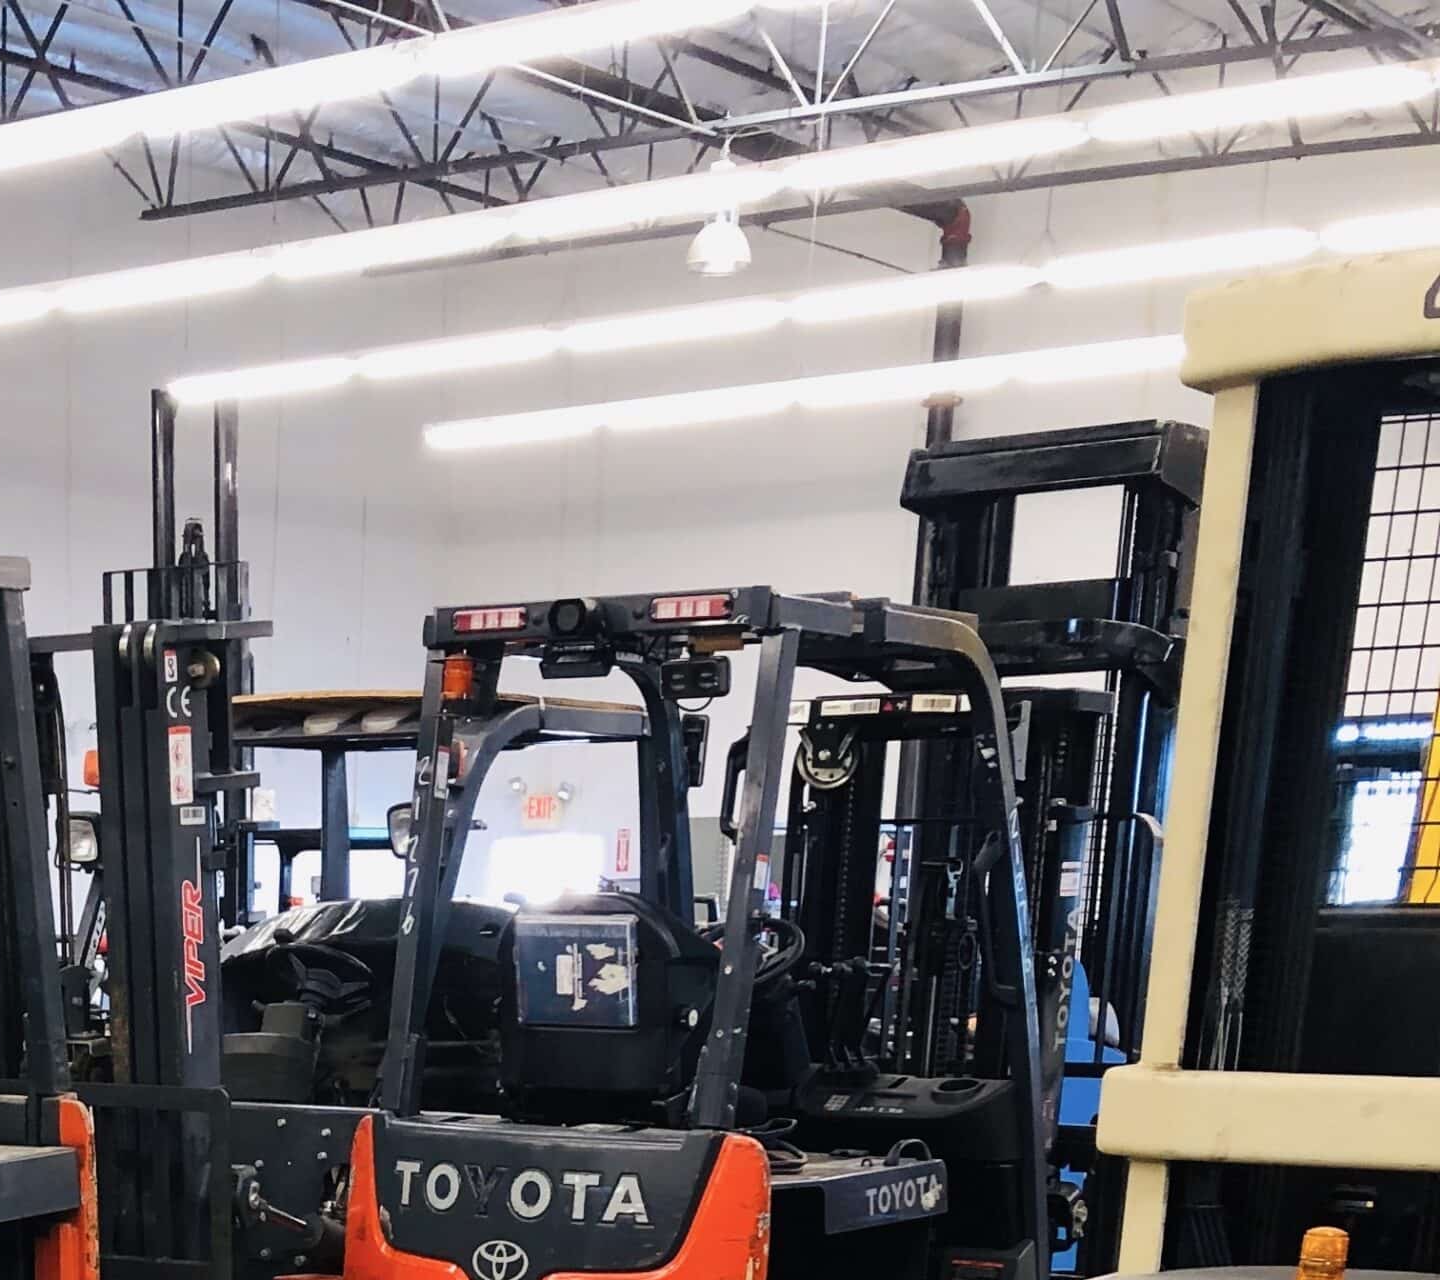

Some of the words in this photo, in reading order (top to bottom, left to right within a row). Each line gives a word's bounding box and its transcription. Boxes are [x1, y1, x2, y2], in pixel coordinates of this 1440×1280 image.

[166, 685, 192, 718] CE
[527, 796, 553, 819] EXIT
[182, 880, 206, 1007] VIPER
[1054, 911, 1081, 1051] TOYOTA
[395, 1160, 650, 1226] TOYOTA
[865, 1174, 940, 1216] TOYOTA
